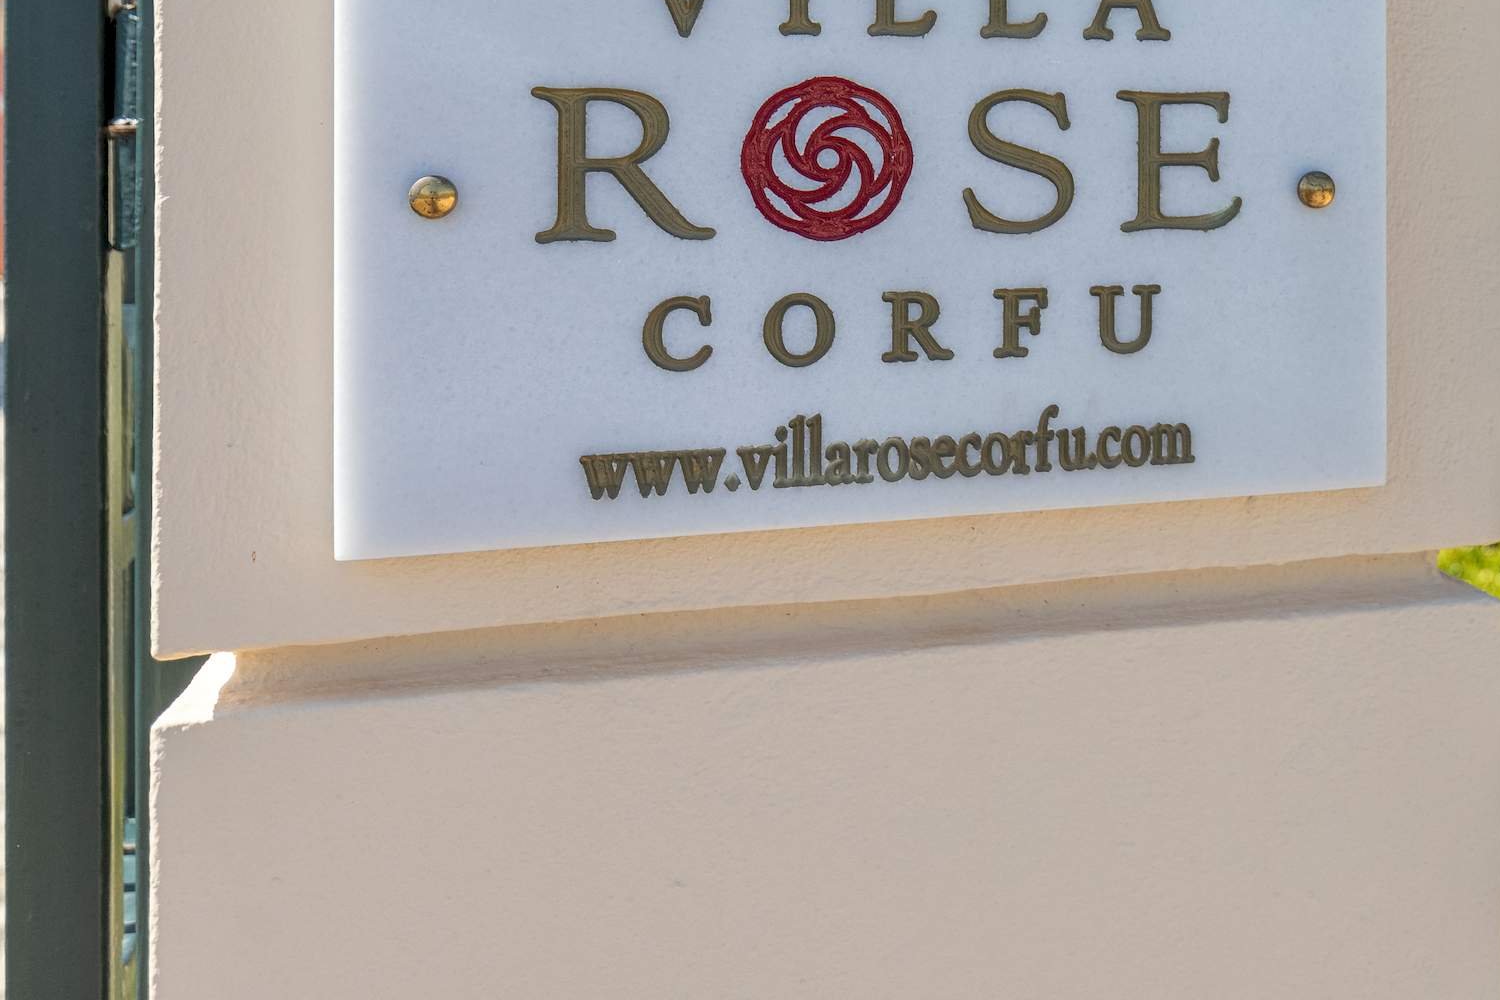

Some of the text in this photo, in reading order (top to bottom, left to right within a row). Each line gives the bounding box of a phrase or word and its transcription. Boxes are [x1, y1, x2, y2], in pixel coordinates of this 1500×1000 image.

[531, 76, 1243, 245] ROSE
[641, 284, 1162, 373] CORFU
[578, 404, 1196, 501] www.villarosecorfu.com
